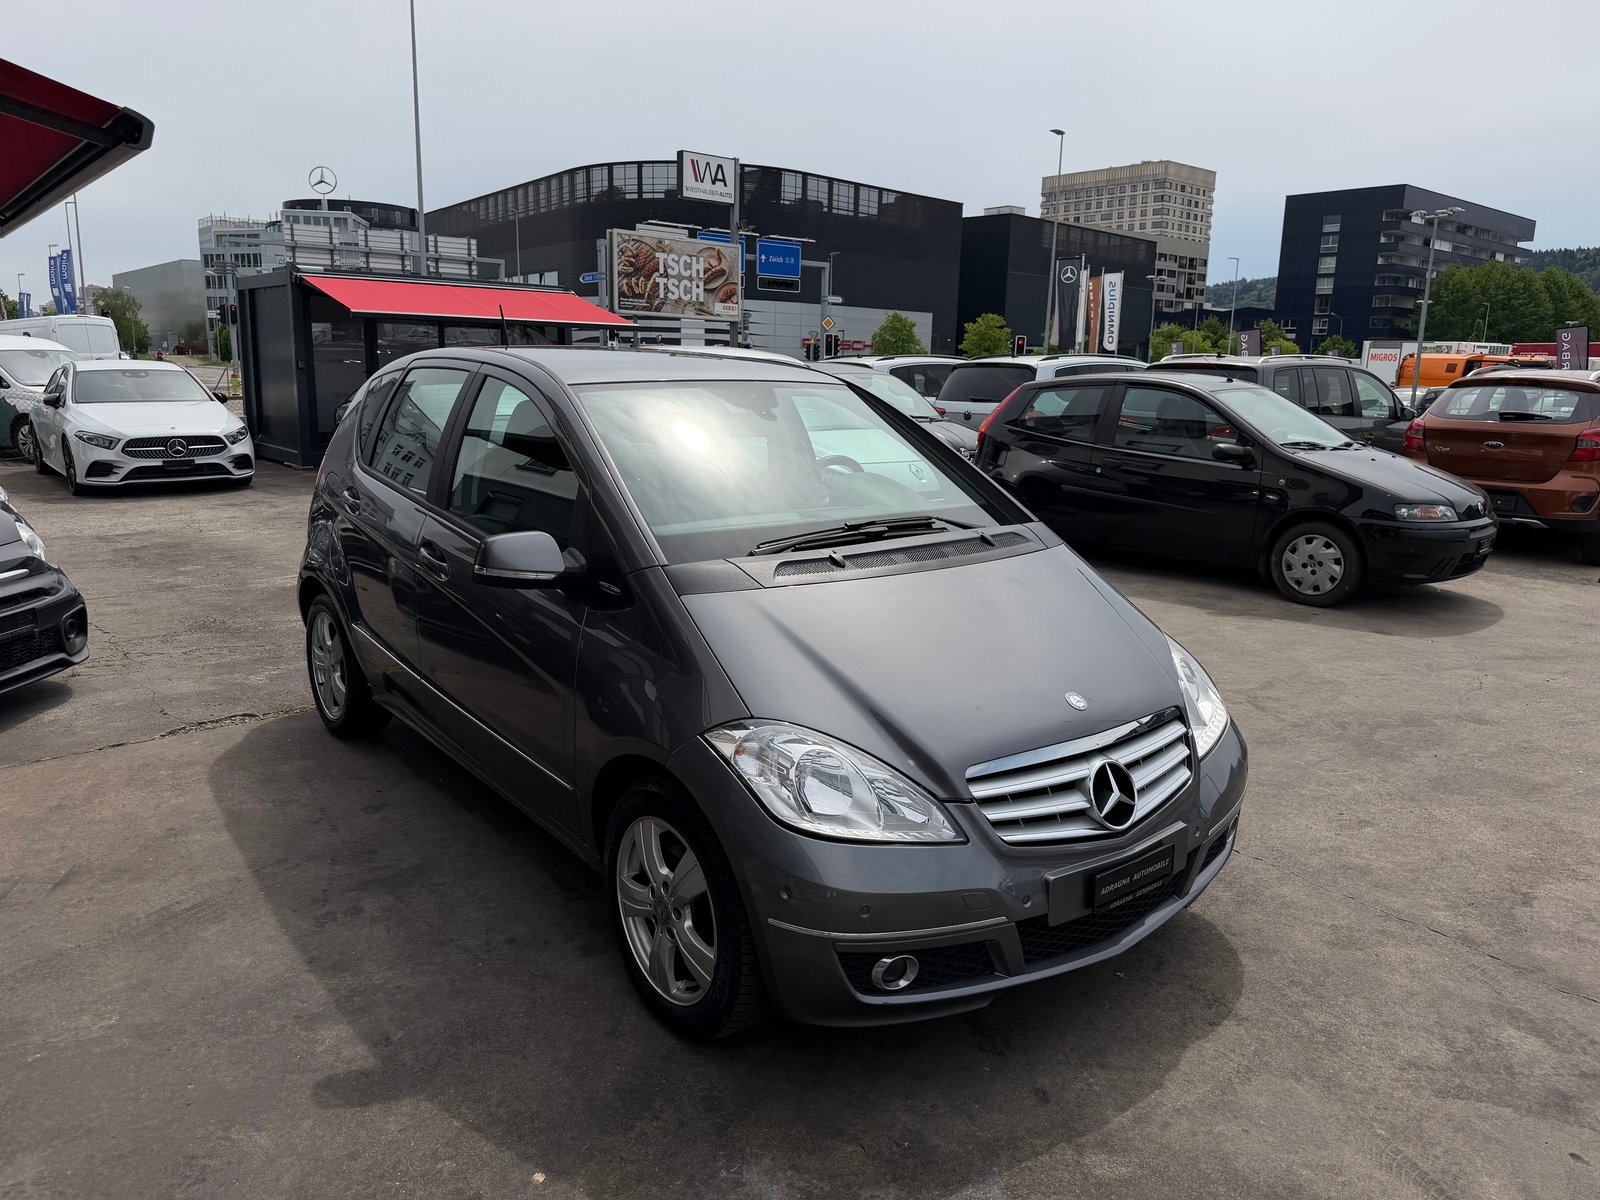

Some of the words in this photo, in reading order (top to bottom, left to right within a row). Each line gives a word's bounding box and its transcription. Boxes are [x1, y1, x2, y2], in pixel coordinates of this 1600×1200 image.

[655, 252, 704, 278] TSCH
[769, 255, 784, 263] Zürich
[655, 277, 704, 302] TSCH
[1370, 353, 1398, 362] MIGROS
[1100, 876, 1131, 896] ADRAGNA
[1132, 858, 1170, 881] AUTOMOBILE
